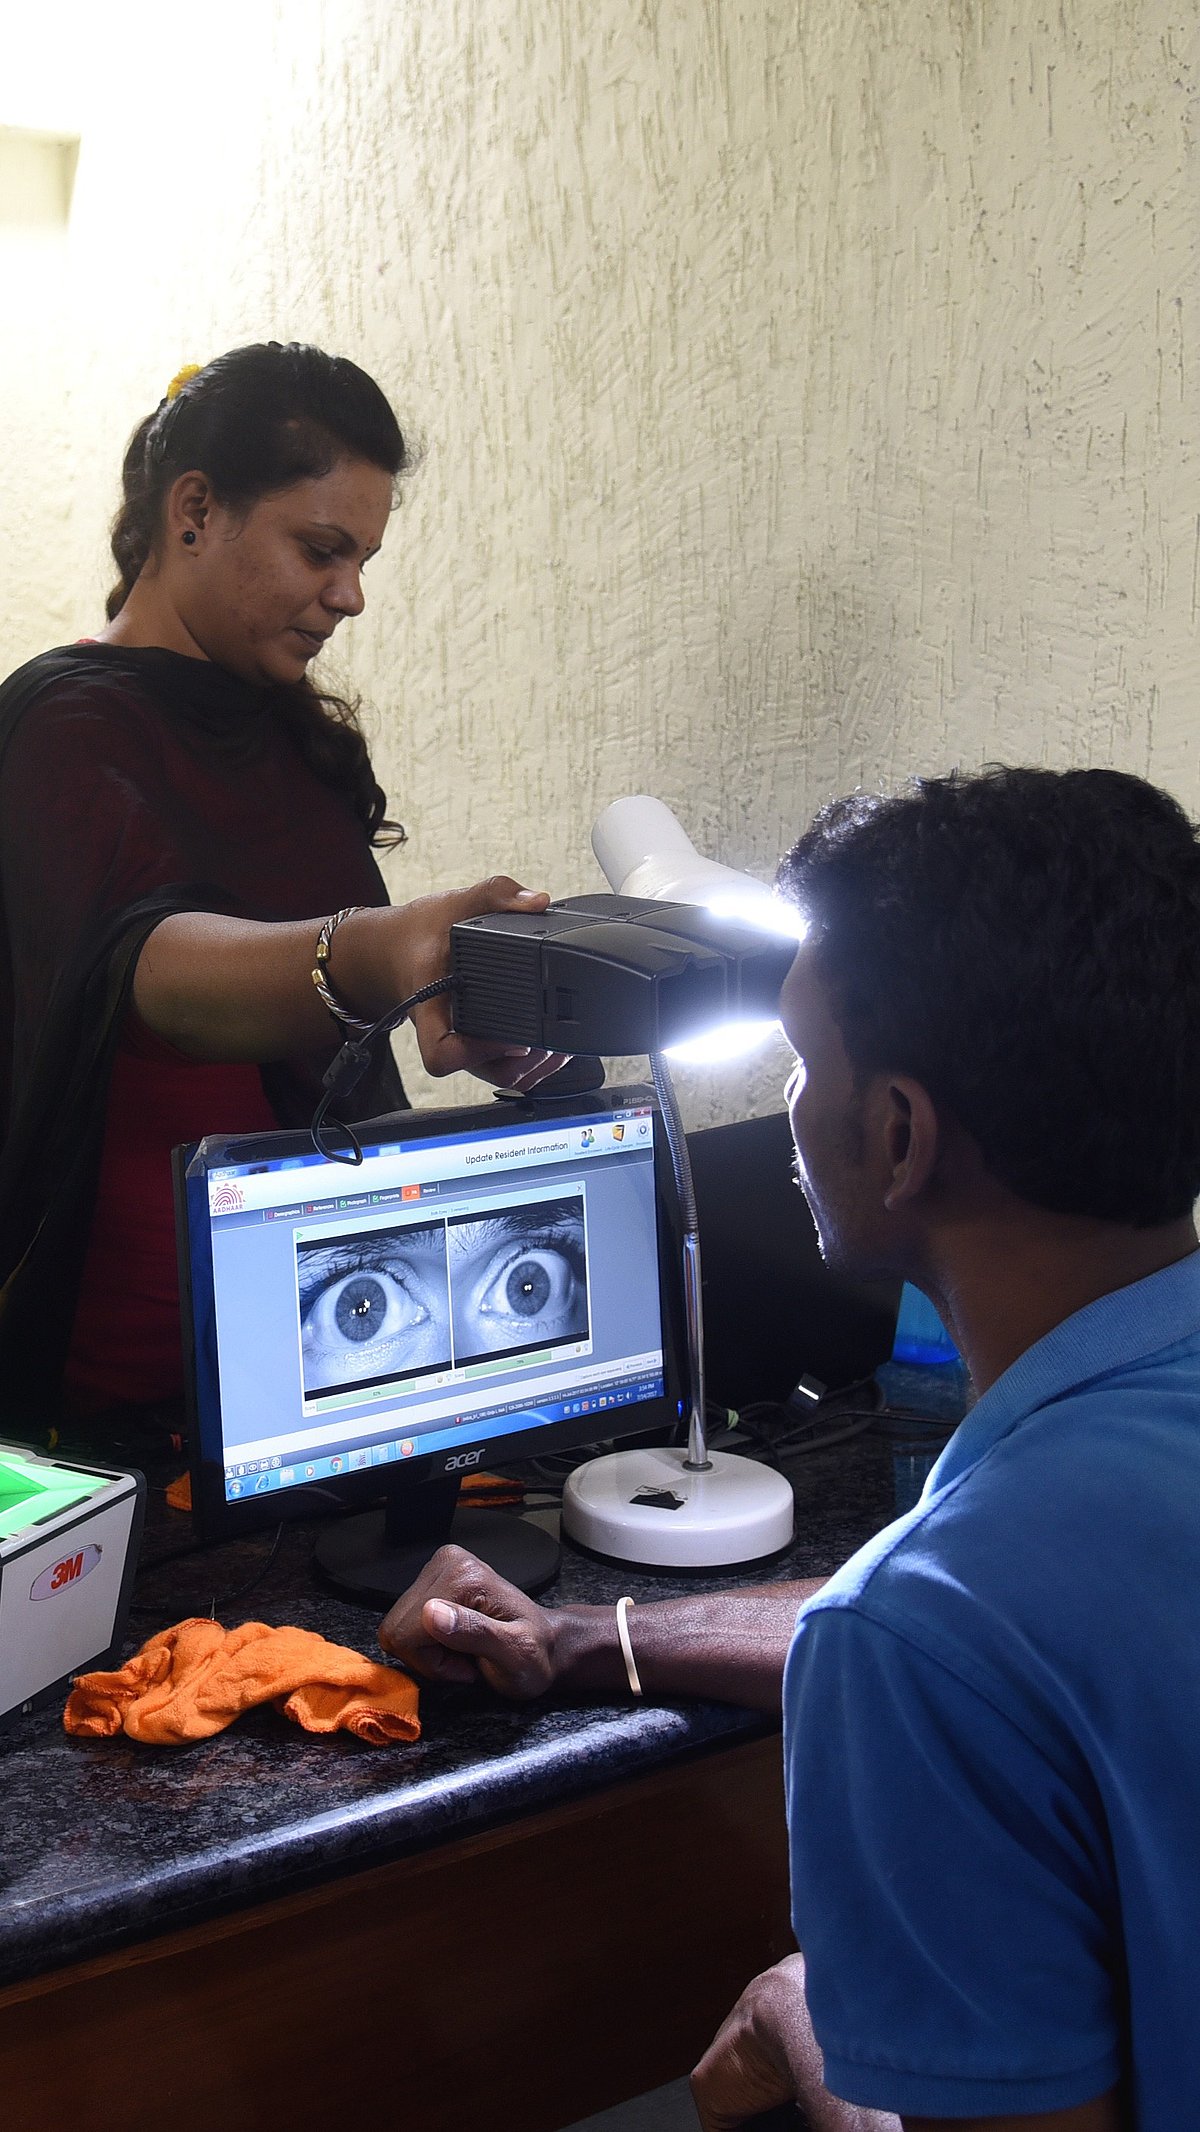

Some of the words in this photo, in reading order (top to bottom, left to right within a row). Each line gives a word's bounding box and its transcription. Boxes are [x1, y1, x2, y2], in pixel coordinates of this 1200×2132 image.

[465, 1153, 493, 1165] Update
[495, 1148, 526, 1160] Resident
[528, 1142, 568, 1154] Information
[213, 1204, 243, 1213] AADHAAR
[444, 1448, 486, 1470] acer
[51, 1551, 84, 1590] 3M
